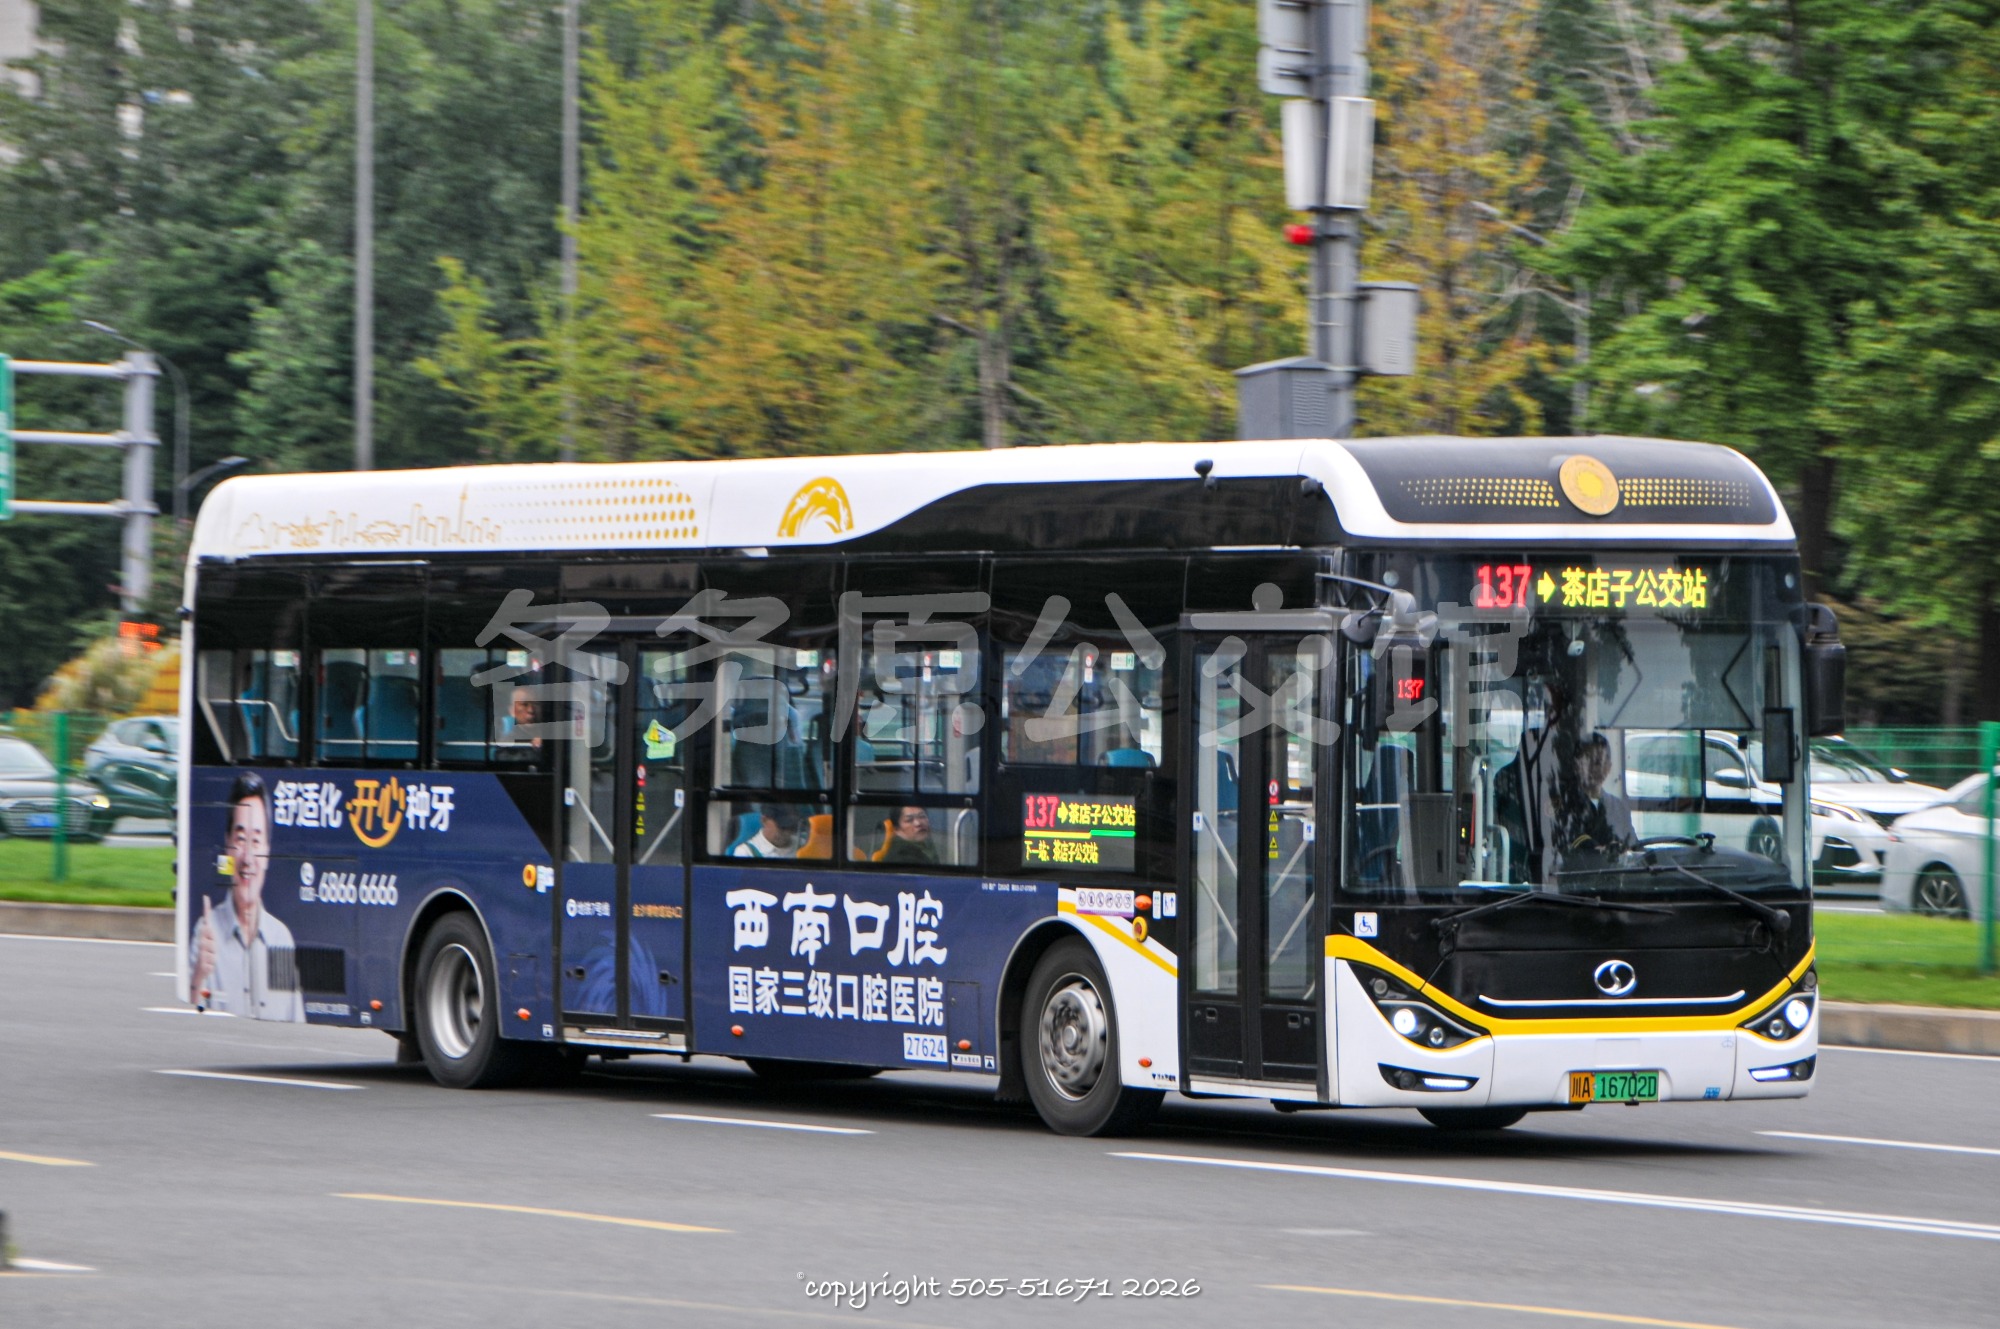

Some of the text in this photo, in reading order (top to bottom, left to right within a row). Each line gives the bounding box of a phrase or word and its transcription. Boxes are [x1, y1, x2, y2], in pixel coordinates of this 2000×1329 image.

[1476, 565, 1532, 608] 137
[1561, 567, 1706, 608] 茶店子公交站
[1397, 679, 1425, 699] 137
[1024, 795, 1059, 827] 137
[1067, 803, 1136, 827] 茶店子公交站
[359, 873, 399, 906] 6666
[725, 883, 948, 966] 西南口腔
[728, 965, 944, 1026] 国家三级口腔医院
[906, 1036, 945, 1059] 27624
[1571, 1076, 1657, 1099] 川A 16702D
